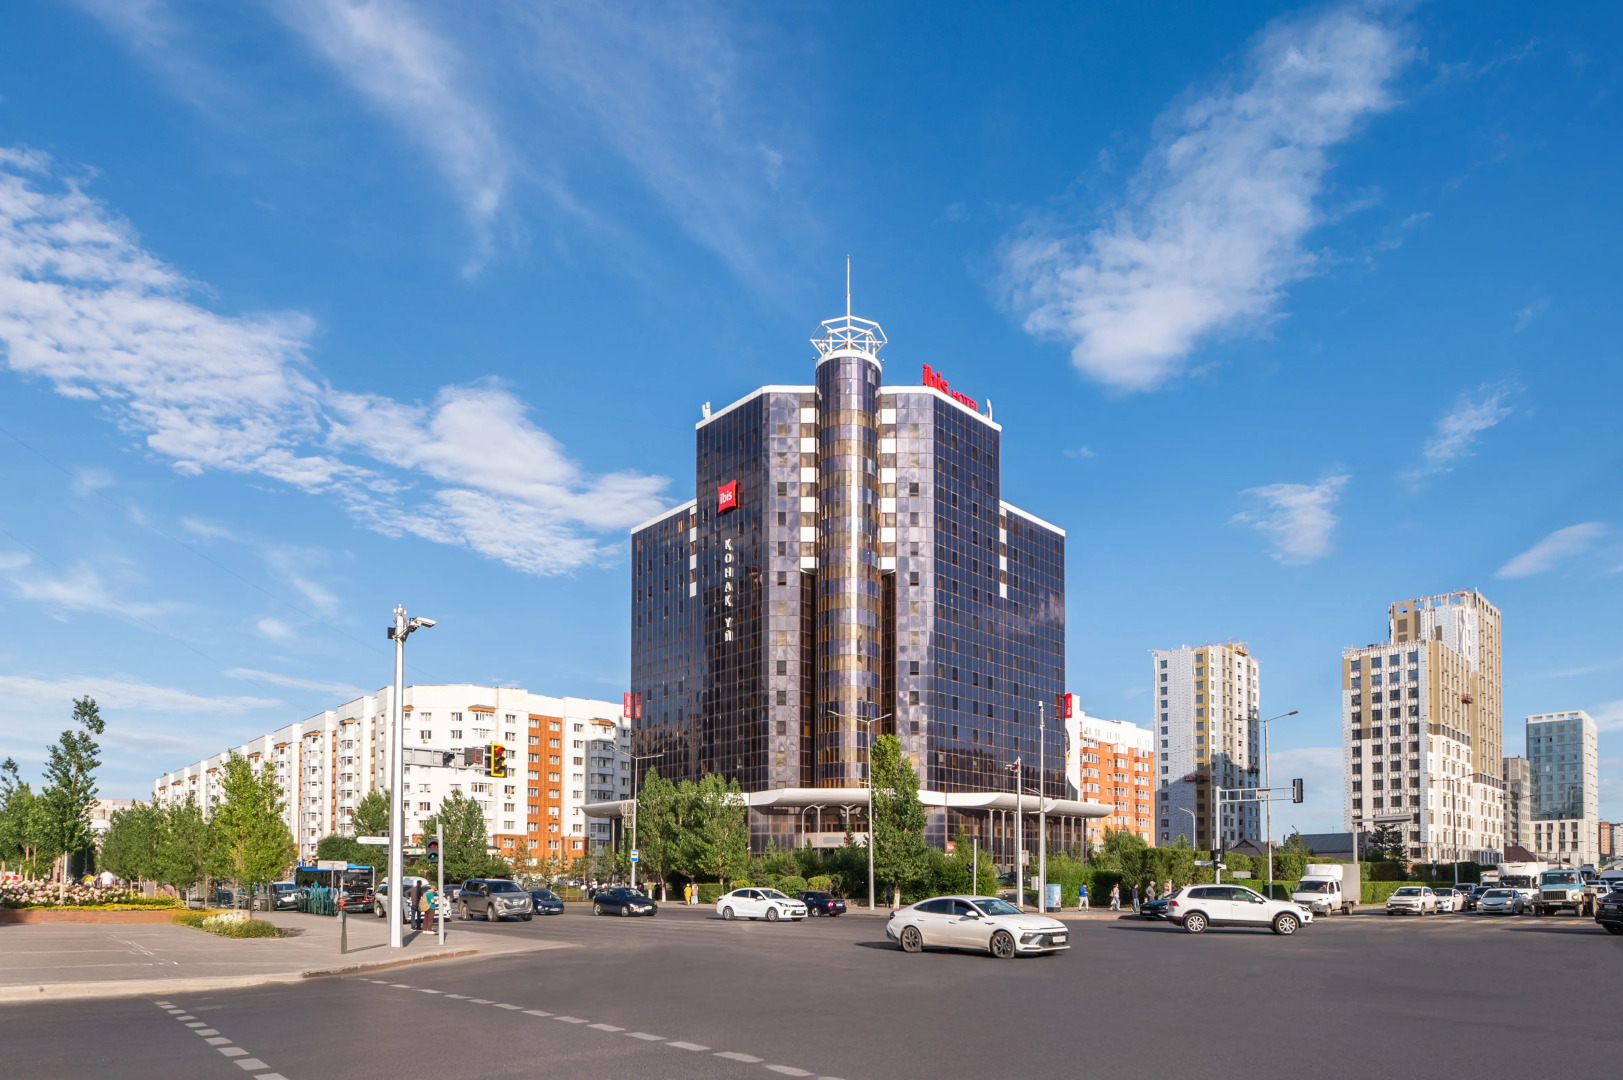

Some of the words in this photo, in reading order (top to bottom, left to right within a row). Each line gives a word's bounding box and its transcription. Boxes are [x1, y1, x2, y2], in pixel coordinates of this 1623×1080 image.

[922, 363, 949, 396] ibis
[951, 388, 978, 412] HOTEL
[719, 489, 733, 504] ibis
